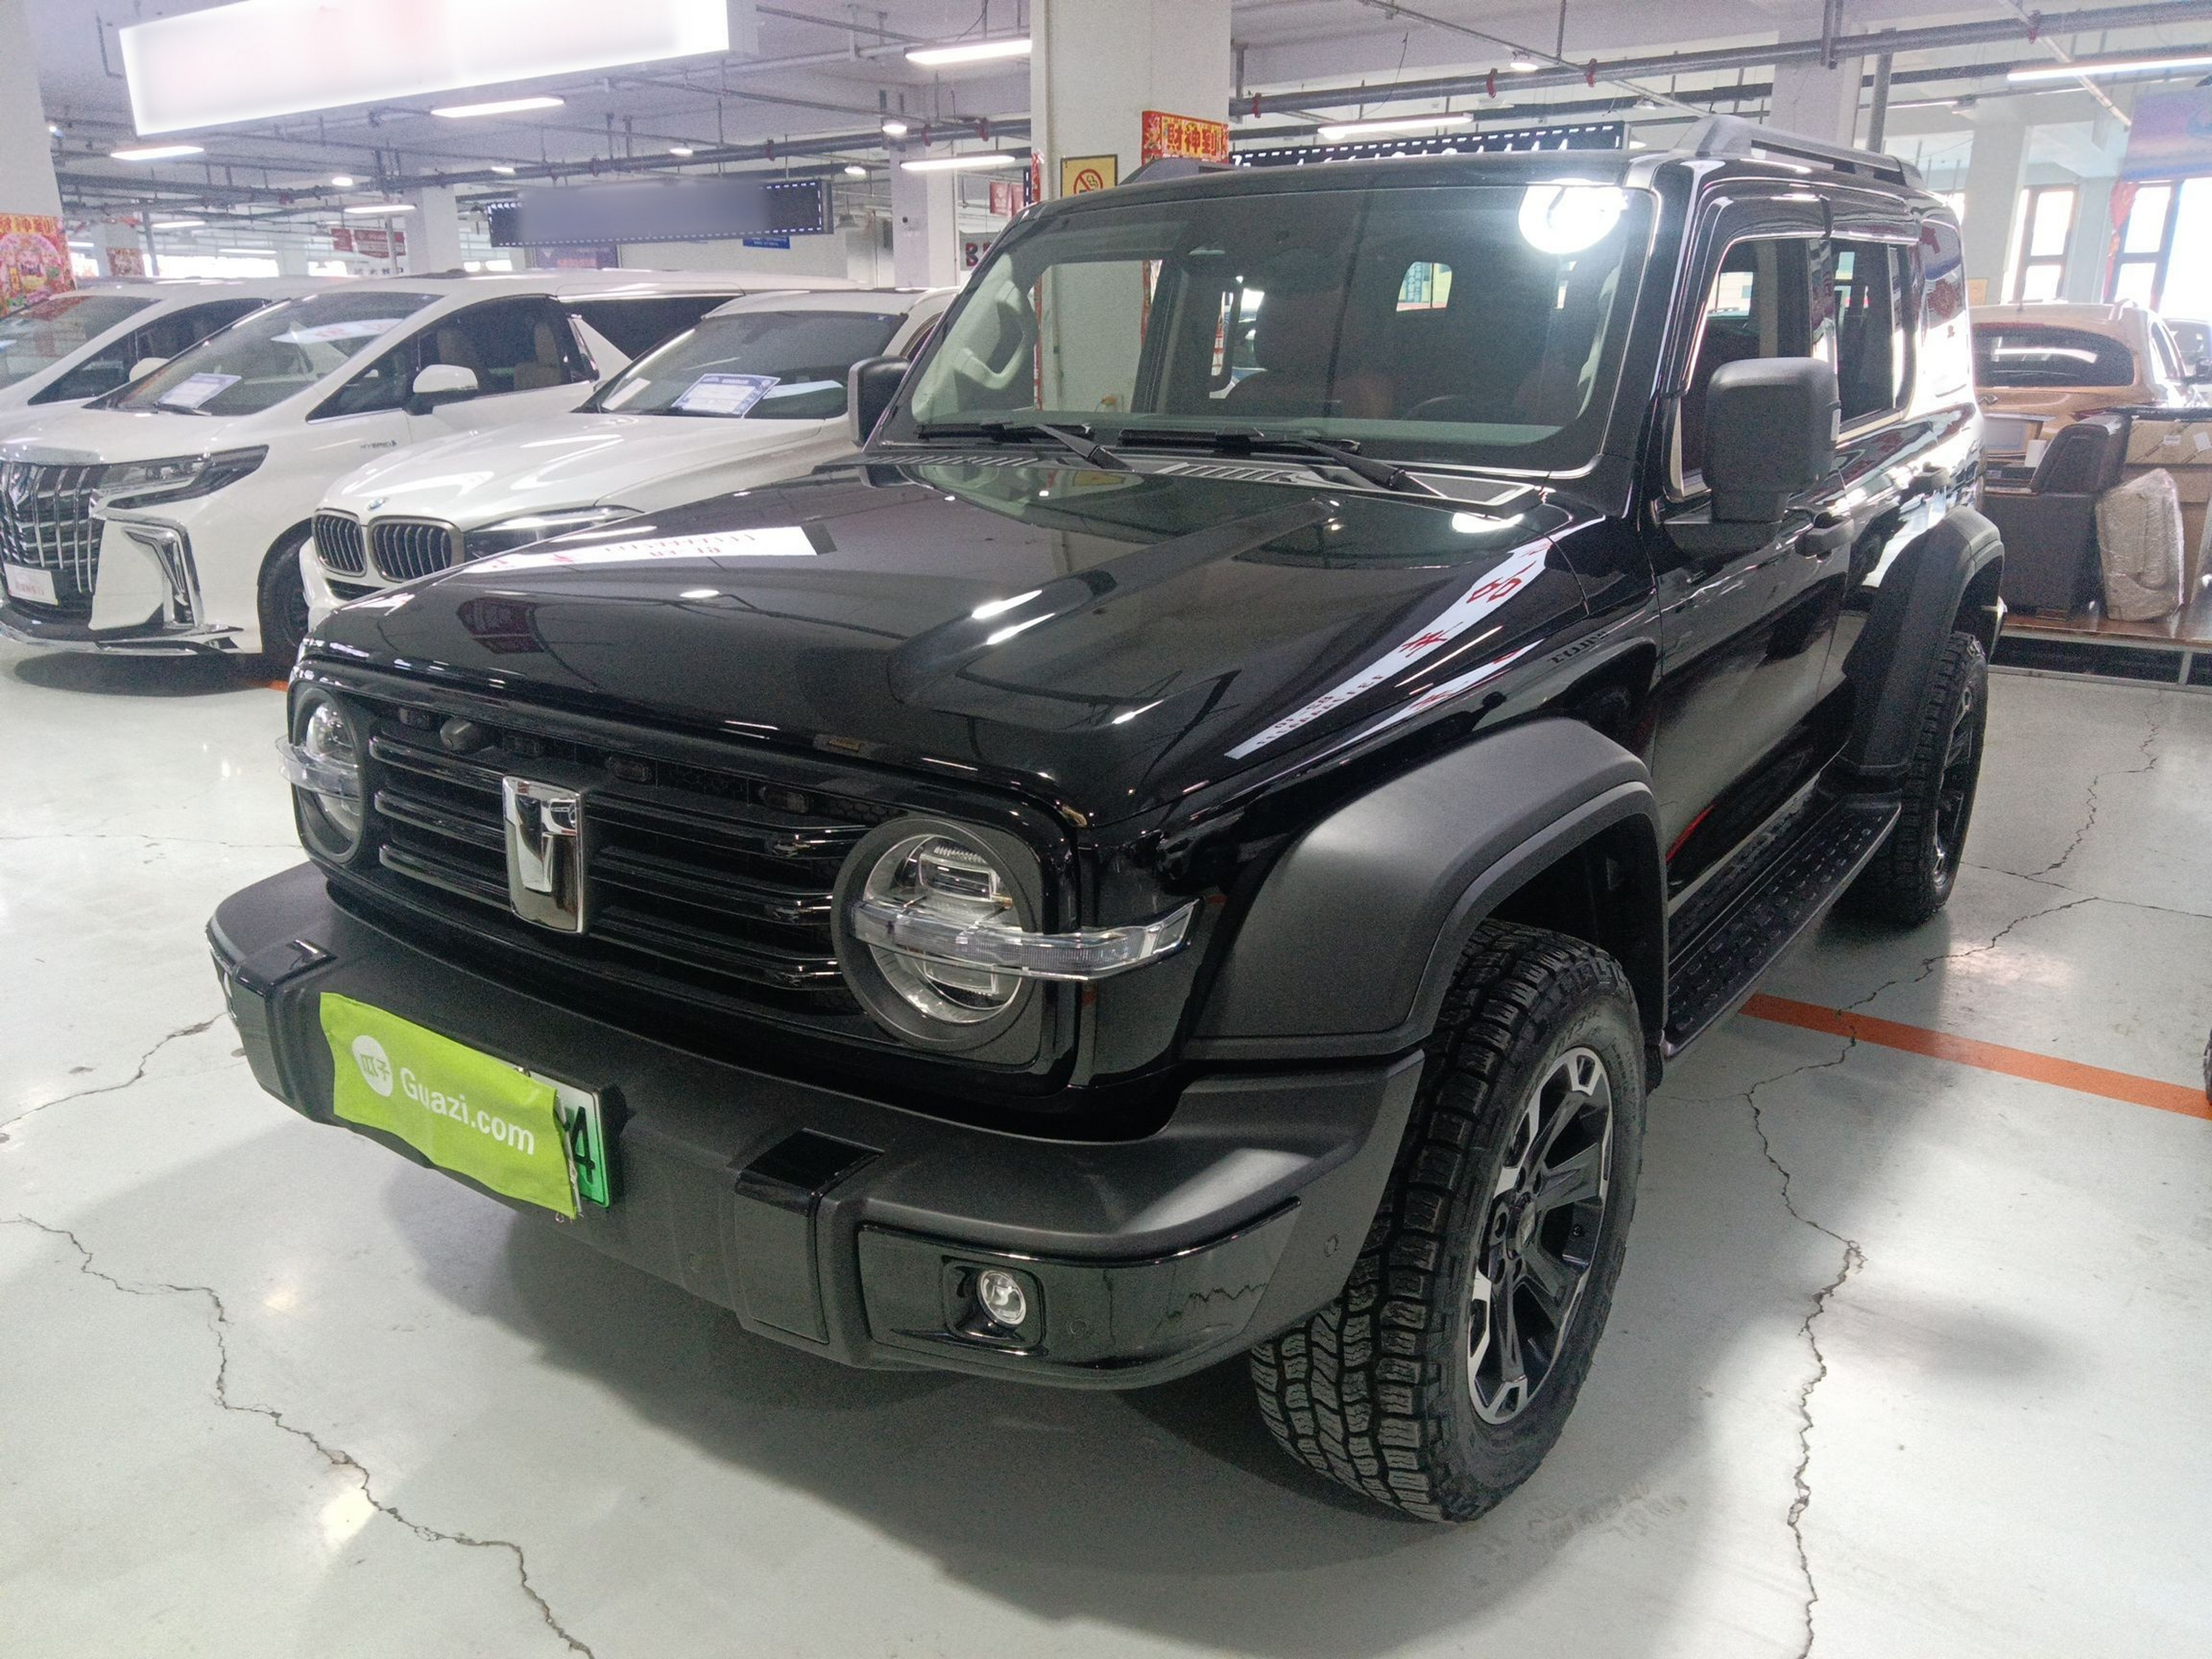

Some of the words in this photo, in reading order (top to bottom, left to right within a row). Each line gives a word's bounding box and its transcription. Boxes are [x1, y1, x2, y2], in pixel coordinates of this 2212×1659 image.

[360, 1052, 390, 1082] 瓜子
[400, 1067, 535, 1156] Guazi.com
[570, 1105, 596, 1185] 4
